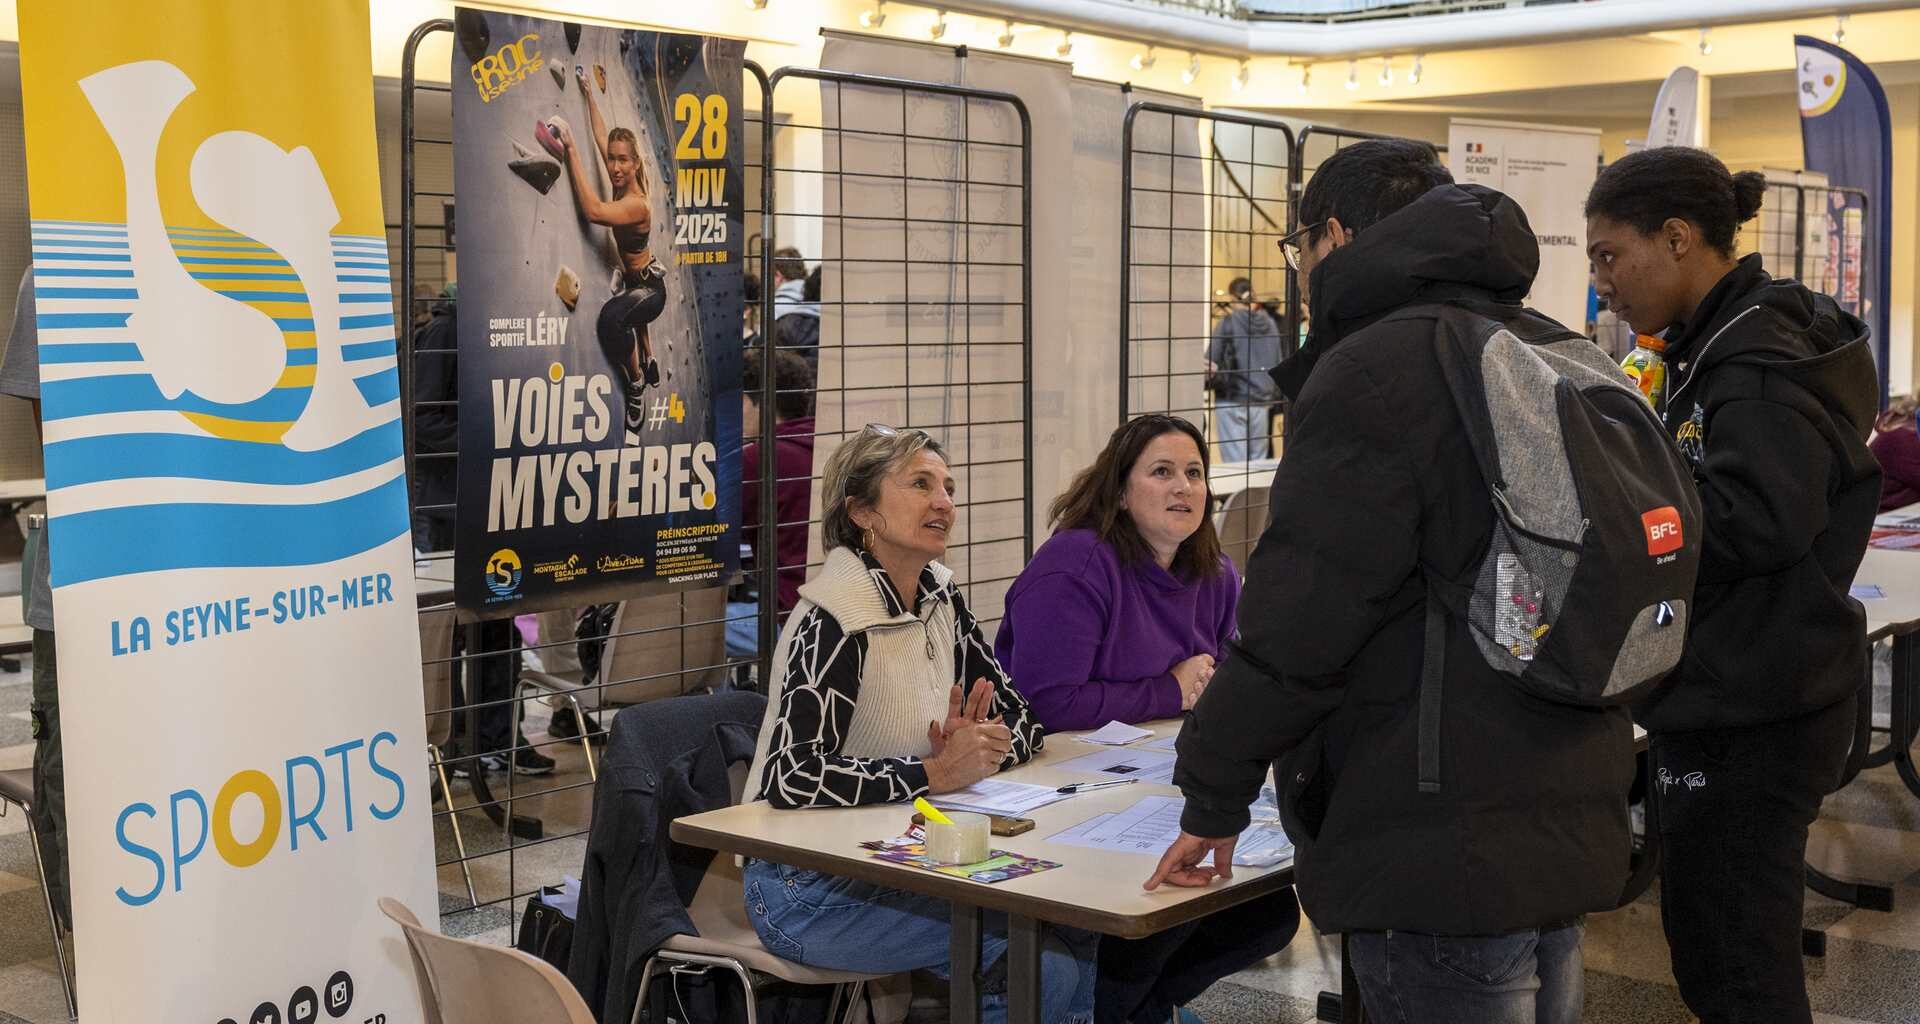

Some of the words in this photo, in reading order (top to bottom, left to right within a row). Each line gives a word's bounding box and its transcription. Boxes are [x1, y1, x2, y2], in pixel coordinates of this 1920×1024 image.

[477, 33, 542, 90] ROC
[675, 93, 728, 160] 28
[676, 168, 729, 208] NOV.
[1465, 165, 1474, 174] DE
[1475, 166, 1490, 175] NICE
[675, 213, 727, 245] 2025
[1538, 234, 1577, 247] EMENTAL
[705, 250, 714, 264] DE
[489, 317, 525, 330] COMPLEXE
[526, 310, 569, 346] LÉRY
[489, 332, 525, 347] SPORTIF
[491, 362, 612, 450] VOIES
[648, 391, 686, 431] #4
[487, 429, 717, 533] MYSTÈRES
[533, 563, 568, 575] MONTAGNE
[554, 567, 588, 578] ESCALADE
[704, 571, 719, 579] PLACE
[111, 615, 152, 658] LA
[165, 572, 395, 647] SEYNE-SUR-MER
[114, 731, 406, 908] SPORTS
